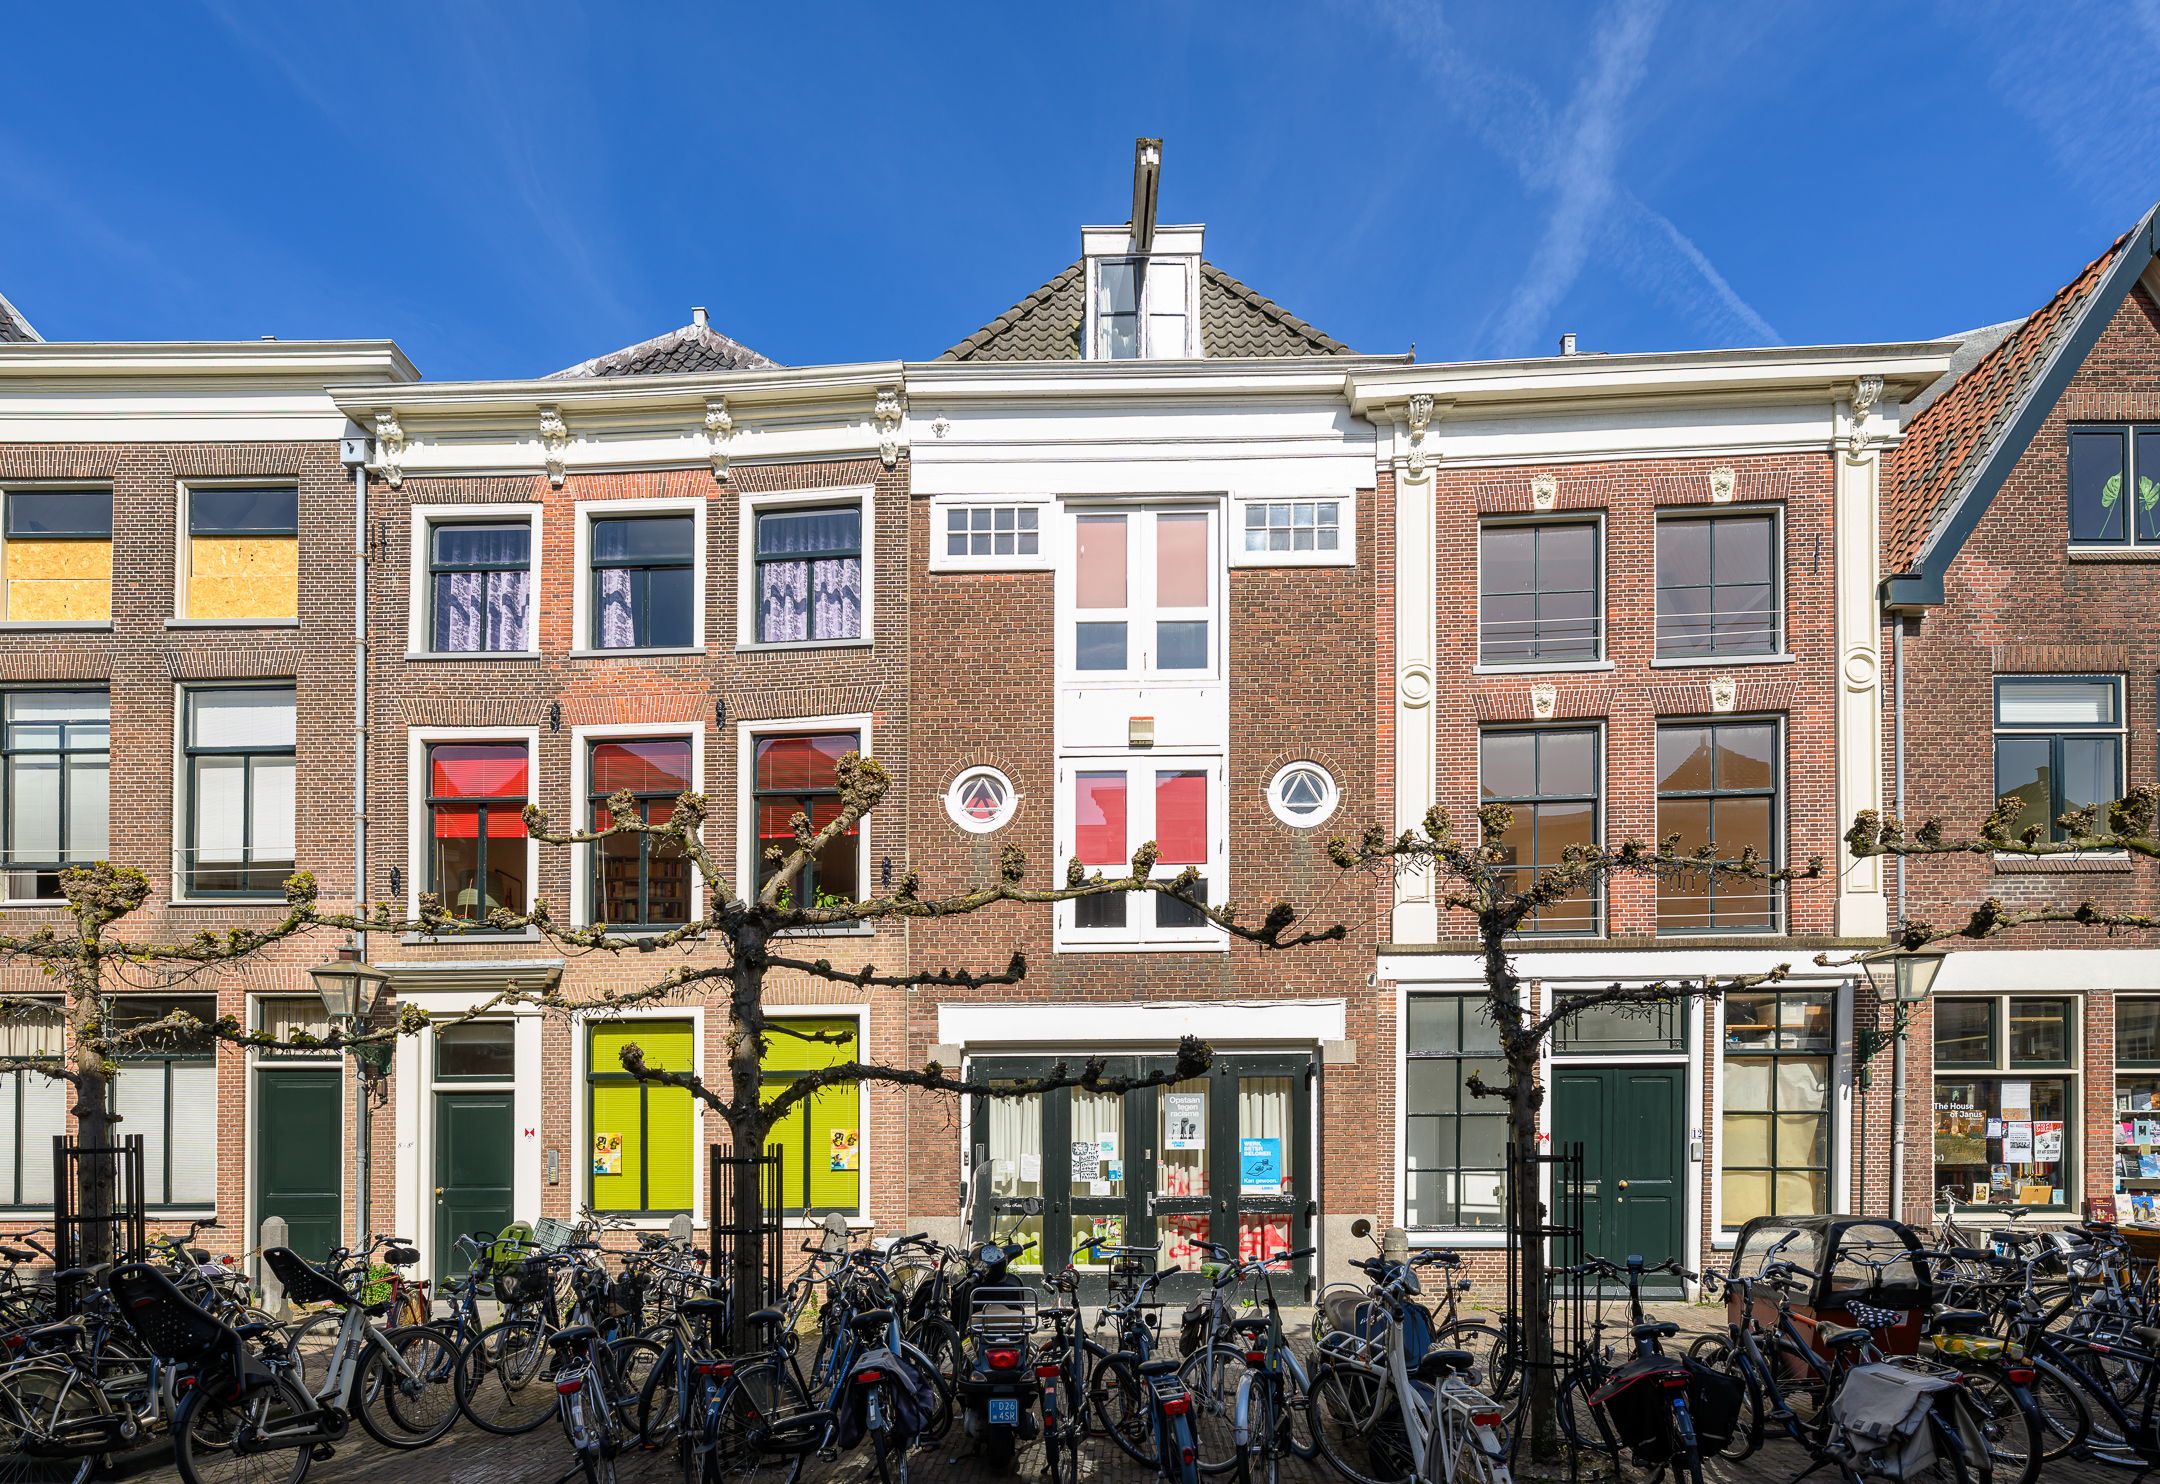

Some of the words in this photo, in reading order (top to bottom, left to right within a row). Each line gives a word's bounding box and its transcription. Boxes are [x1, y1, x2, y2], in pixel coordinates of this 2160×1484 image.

[1169, 1096, 1200, 1104] Opstaan
[999, 1402, 1015, 1410] D26
[999, 1412, 1015, 1420] 4SR
